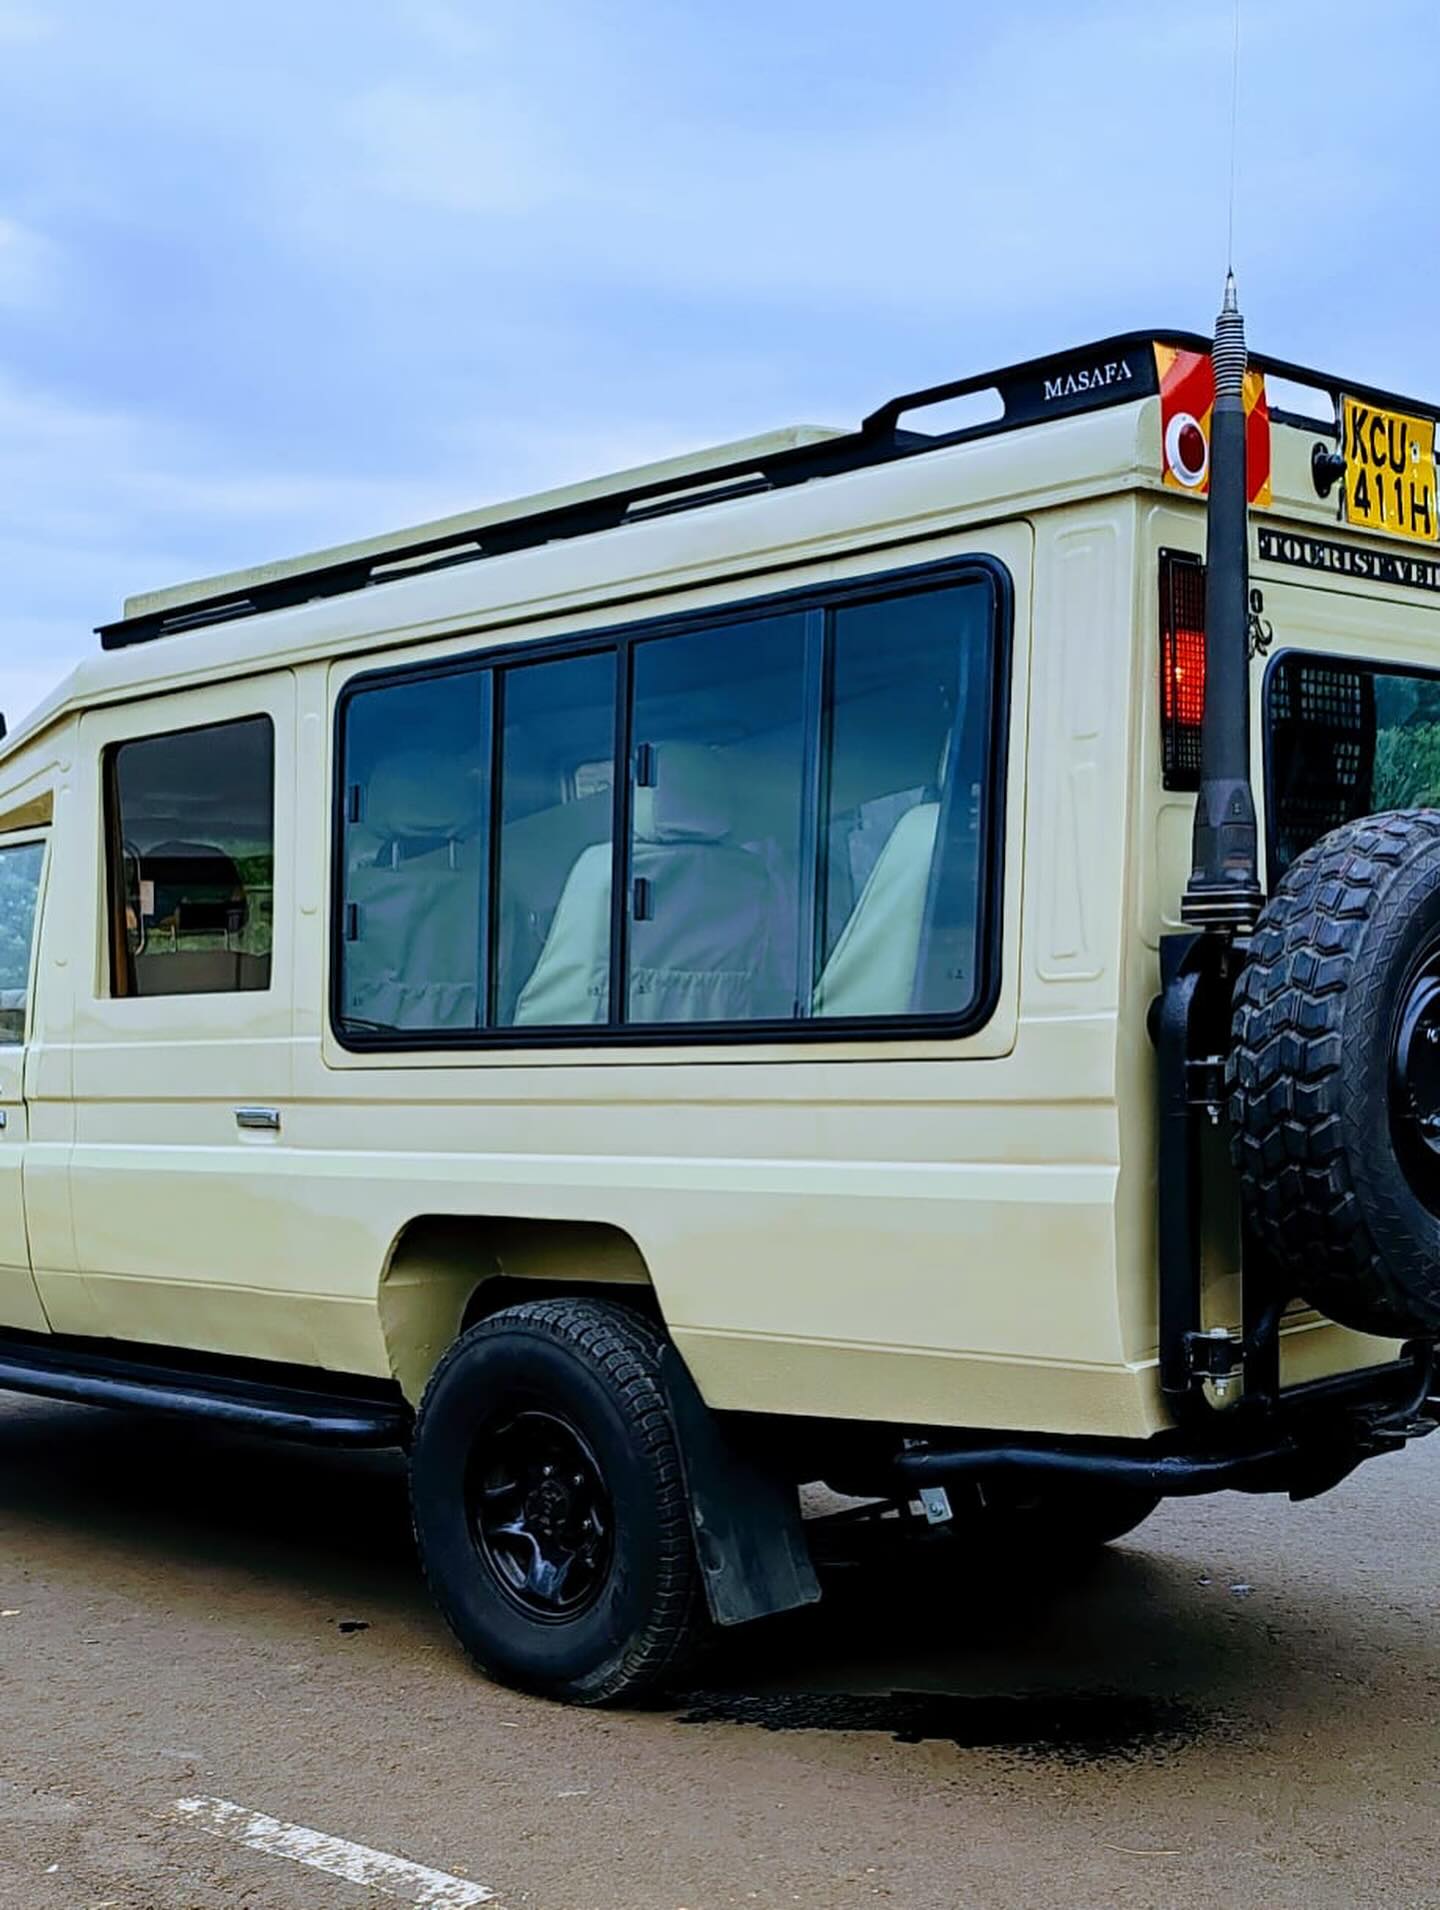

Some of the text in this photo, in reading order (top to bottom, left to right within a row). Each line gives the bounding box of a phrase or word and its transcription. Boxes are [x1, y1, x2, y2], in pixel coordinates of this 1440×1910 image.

[1043, 360, 1132, 401] MASAFA
[1351, 405, 1407, 474] KCU
[1354, 467, 1431, 534] 411H
[1265, 535, 1385, 577] TOURIST
